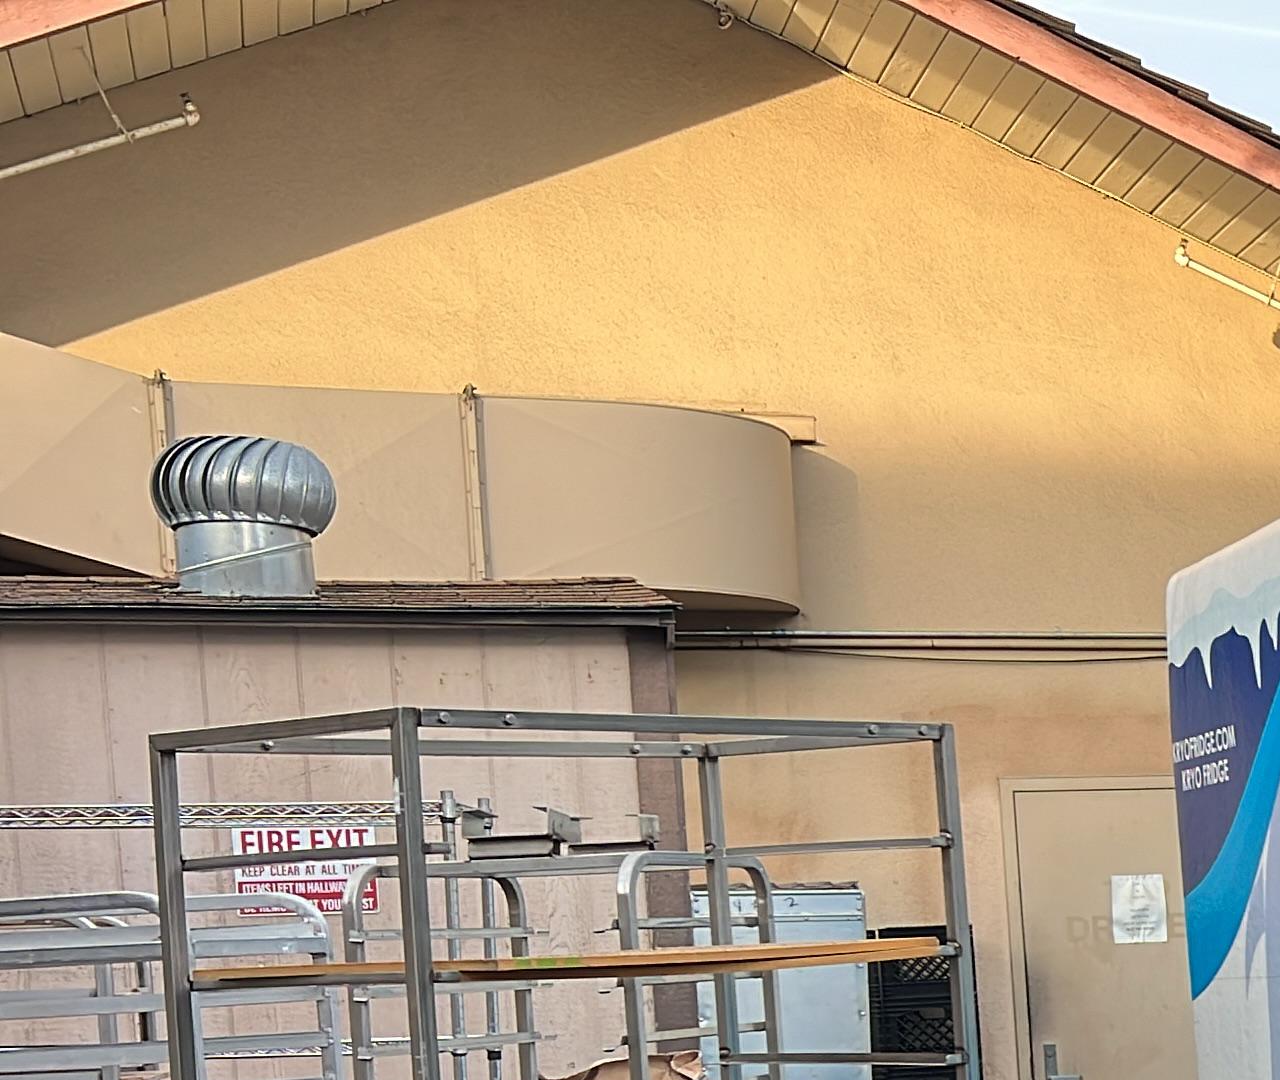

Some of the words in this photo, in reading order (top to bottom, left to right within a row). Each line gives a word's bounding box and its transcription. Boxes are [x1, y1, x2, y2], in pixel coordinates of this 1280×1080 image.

[1173, 725, 1236, 763] KRYOFRIDGE.COM
[1181, 766, 1202, 791] KRYO
[1202, 759, 1229, 786] FRIDGE
[240, 830, 300, 854] FIRE
[310, 829, 369, 849] EXIT
[241, 865, 264, 877] KEEP
[270, 864, 300, 876] CLEAR
[305, 864, 316, 875] AT
[321, 863, 338, 875] ALL
